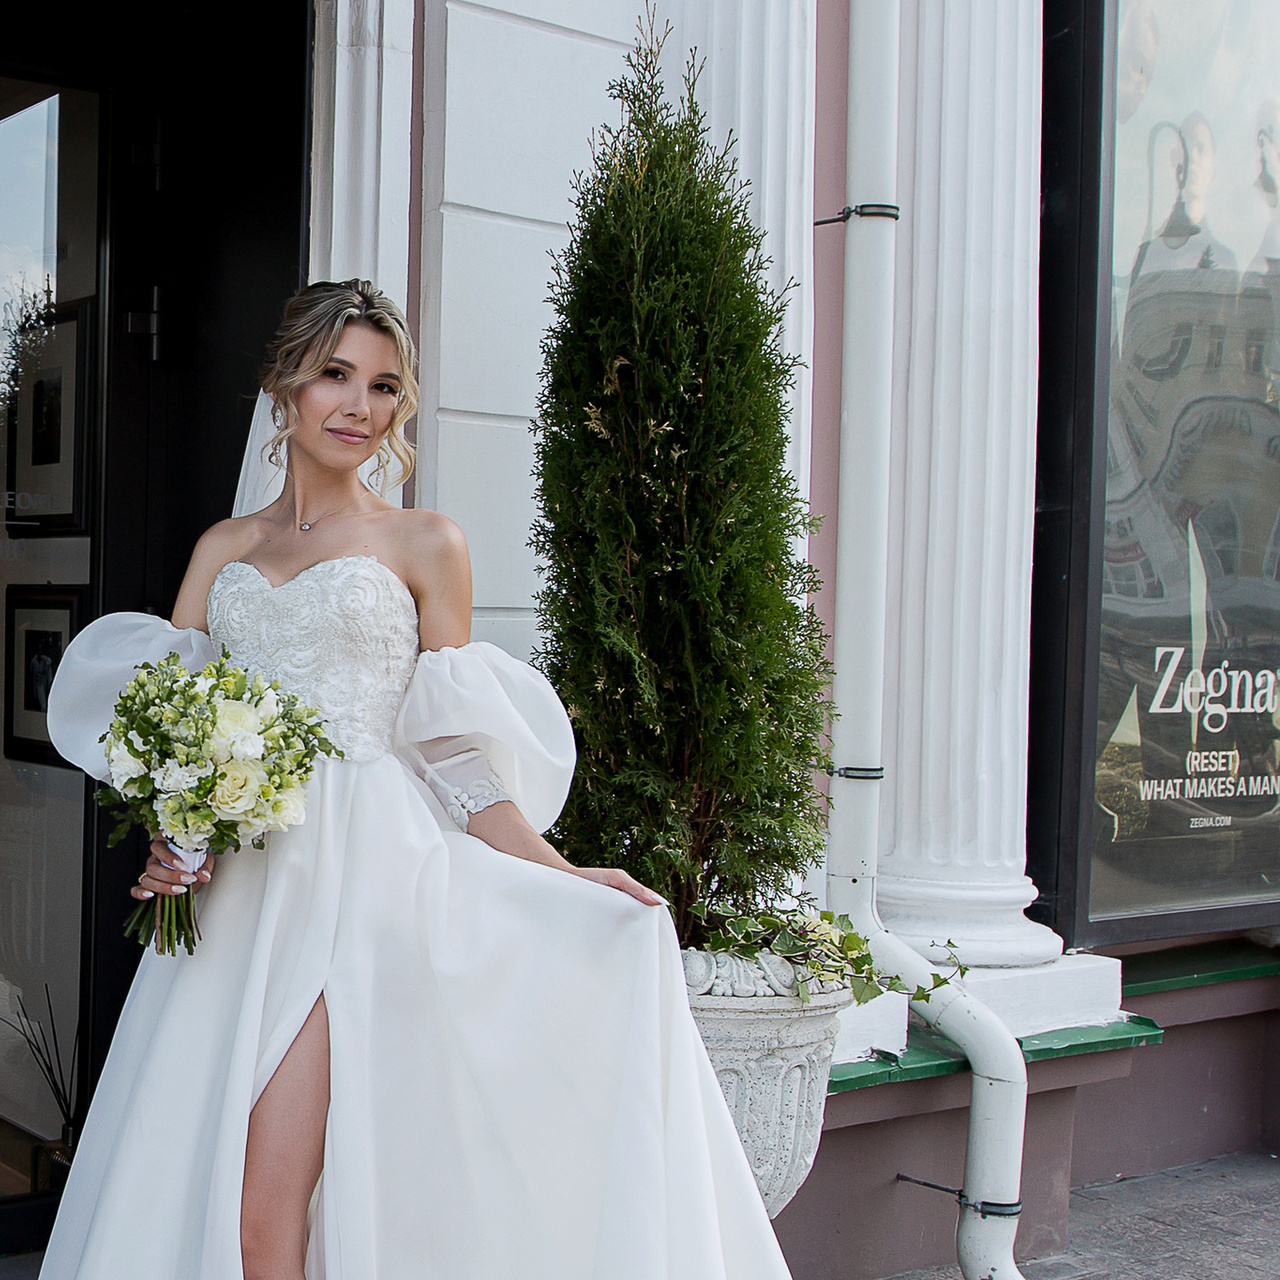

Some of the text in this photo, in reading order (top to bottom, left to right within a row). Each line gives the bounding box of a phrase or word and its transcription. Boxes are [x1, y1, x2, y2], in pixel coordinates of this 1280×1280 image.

[1149, 646, 1278, 733] Zegna
[1185, 750, 1240, 775] (RESET)
[1139, 775, 1280, 800] WHAT MAKES A MAN
[1189, 816, 1232, 829] ZEGNA.COM
